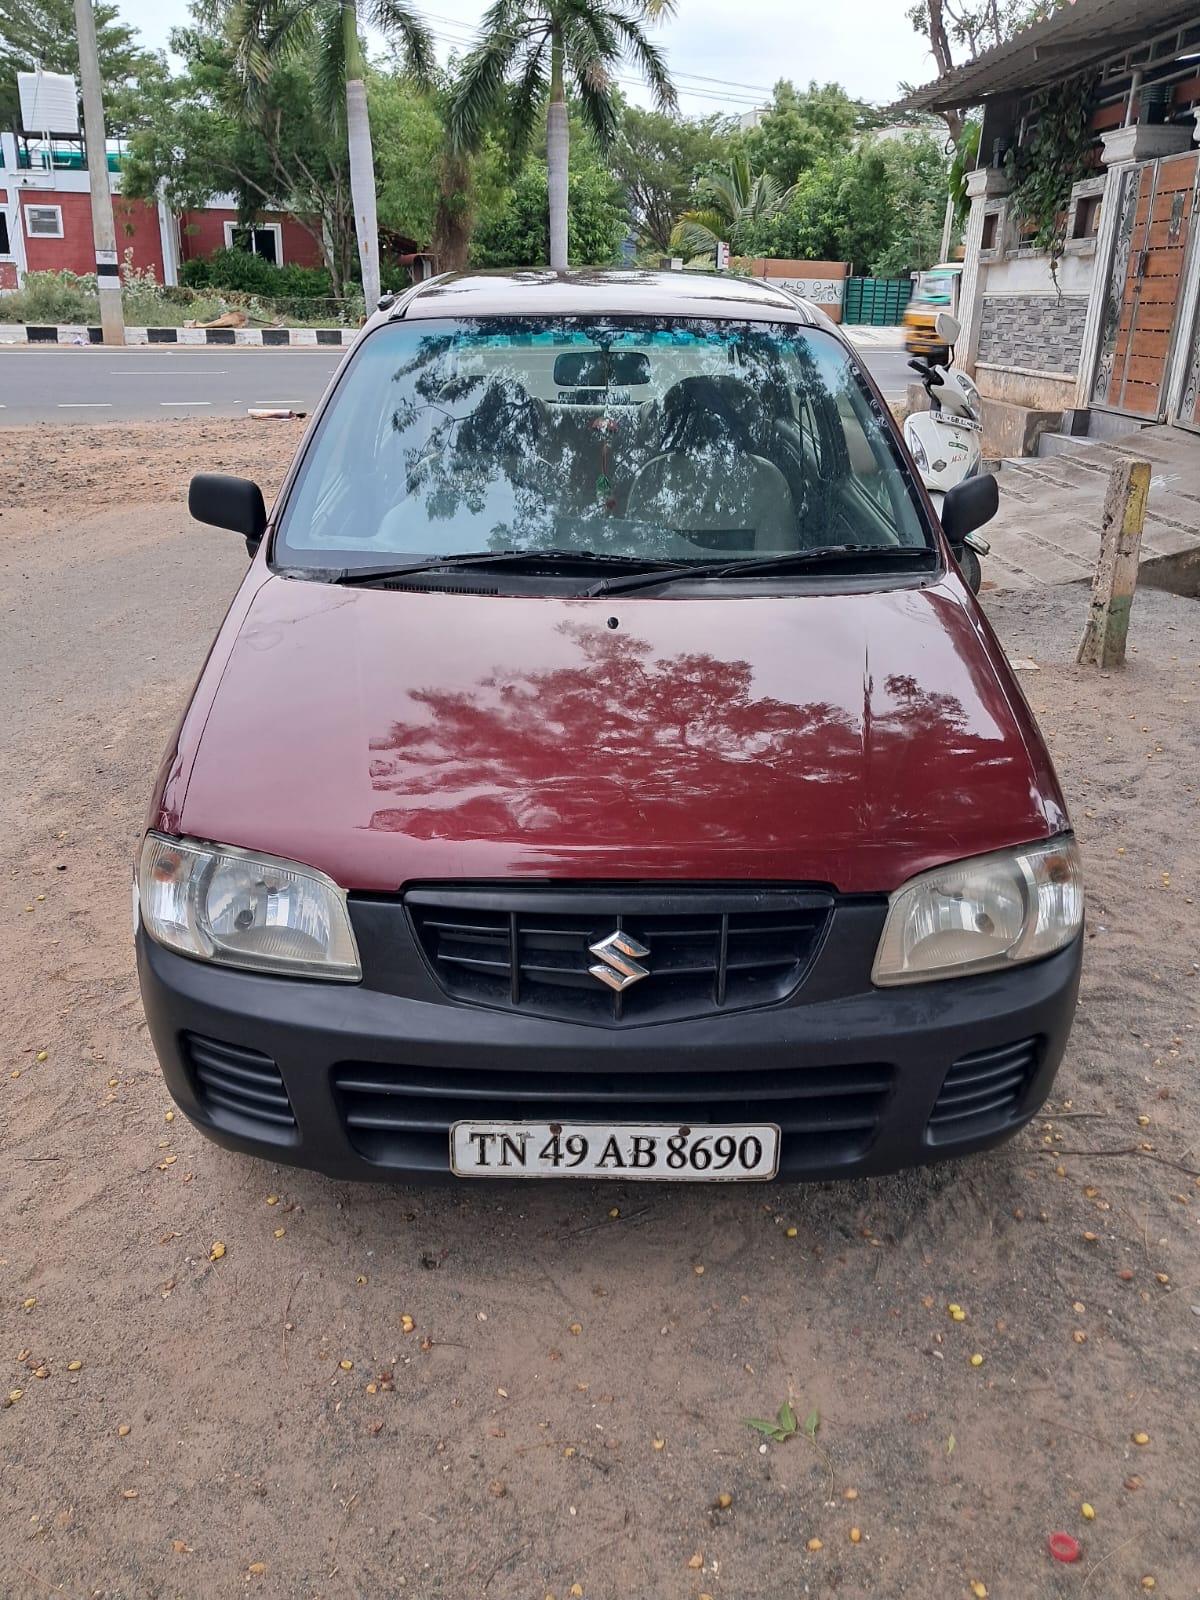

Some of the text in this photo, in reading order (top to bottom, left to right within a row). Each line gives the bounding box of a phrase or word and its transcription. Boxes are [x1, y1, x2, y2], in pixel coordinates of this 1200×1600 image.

[469, 1132, 761, 1170] TN 49 AB 8690
